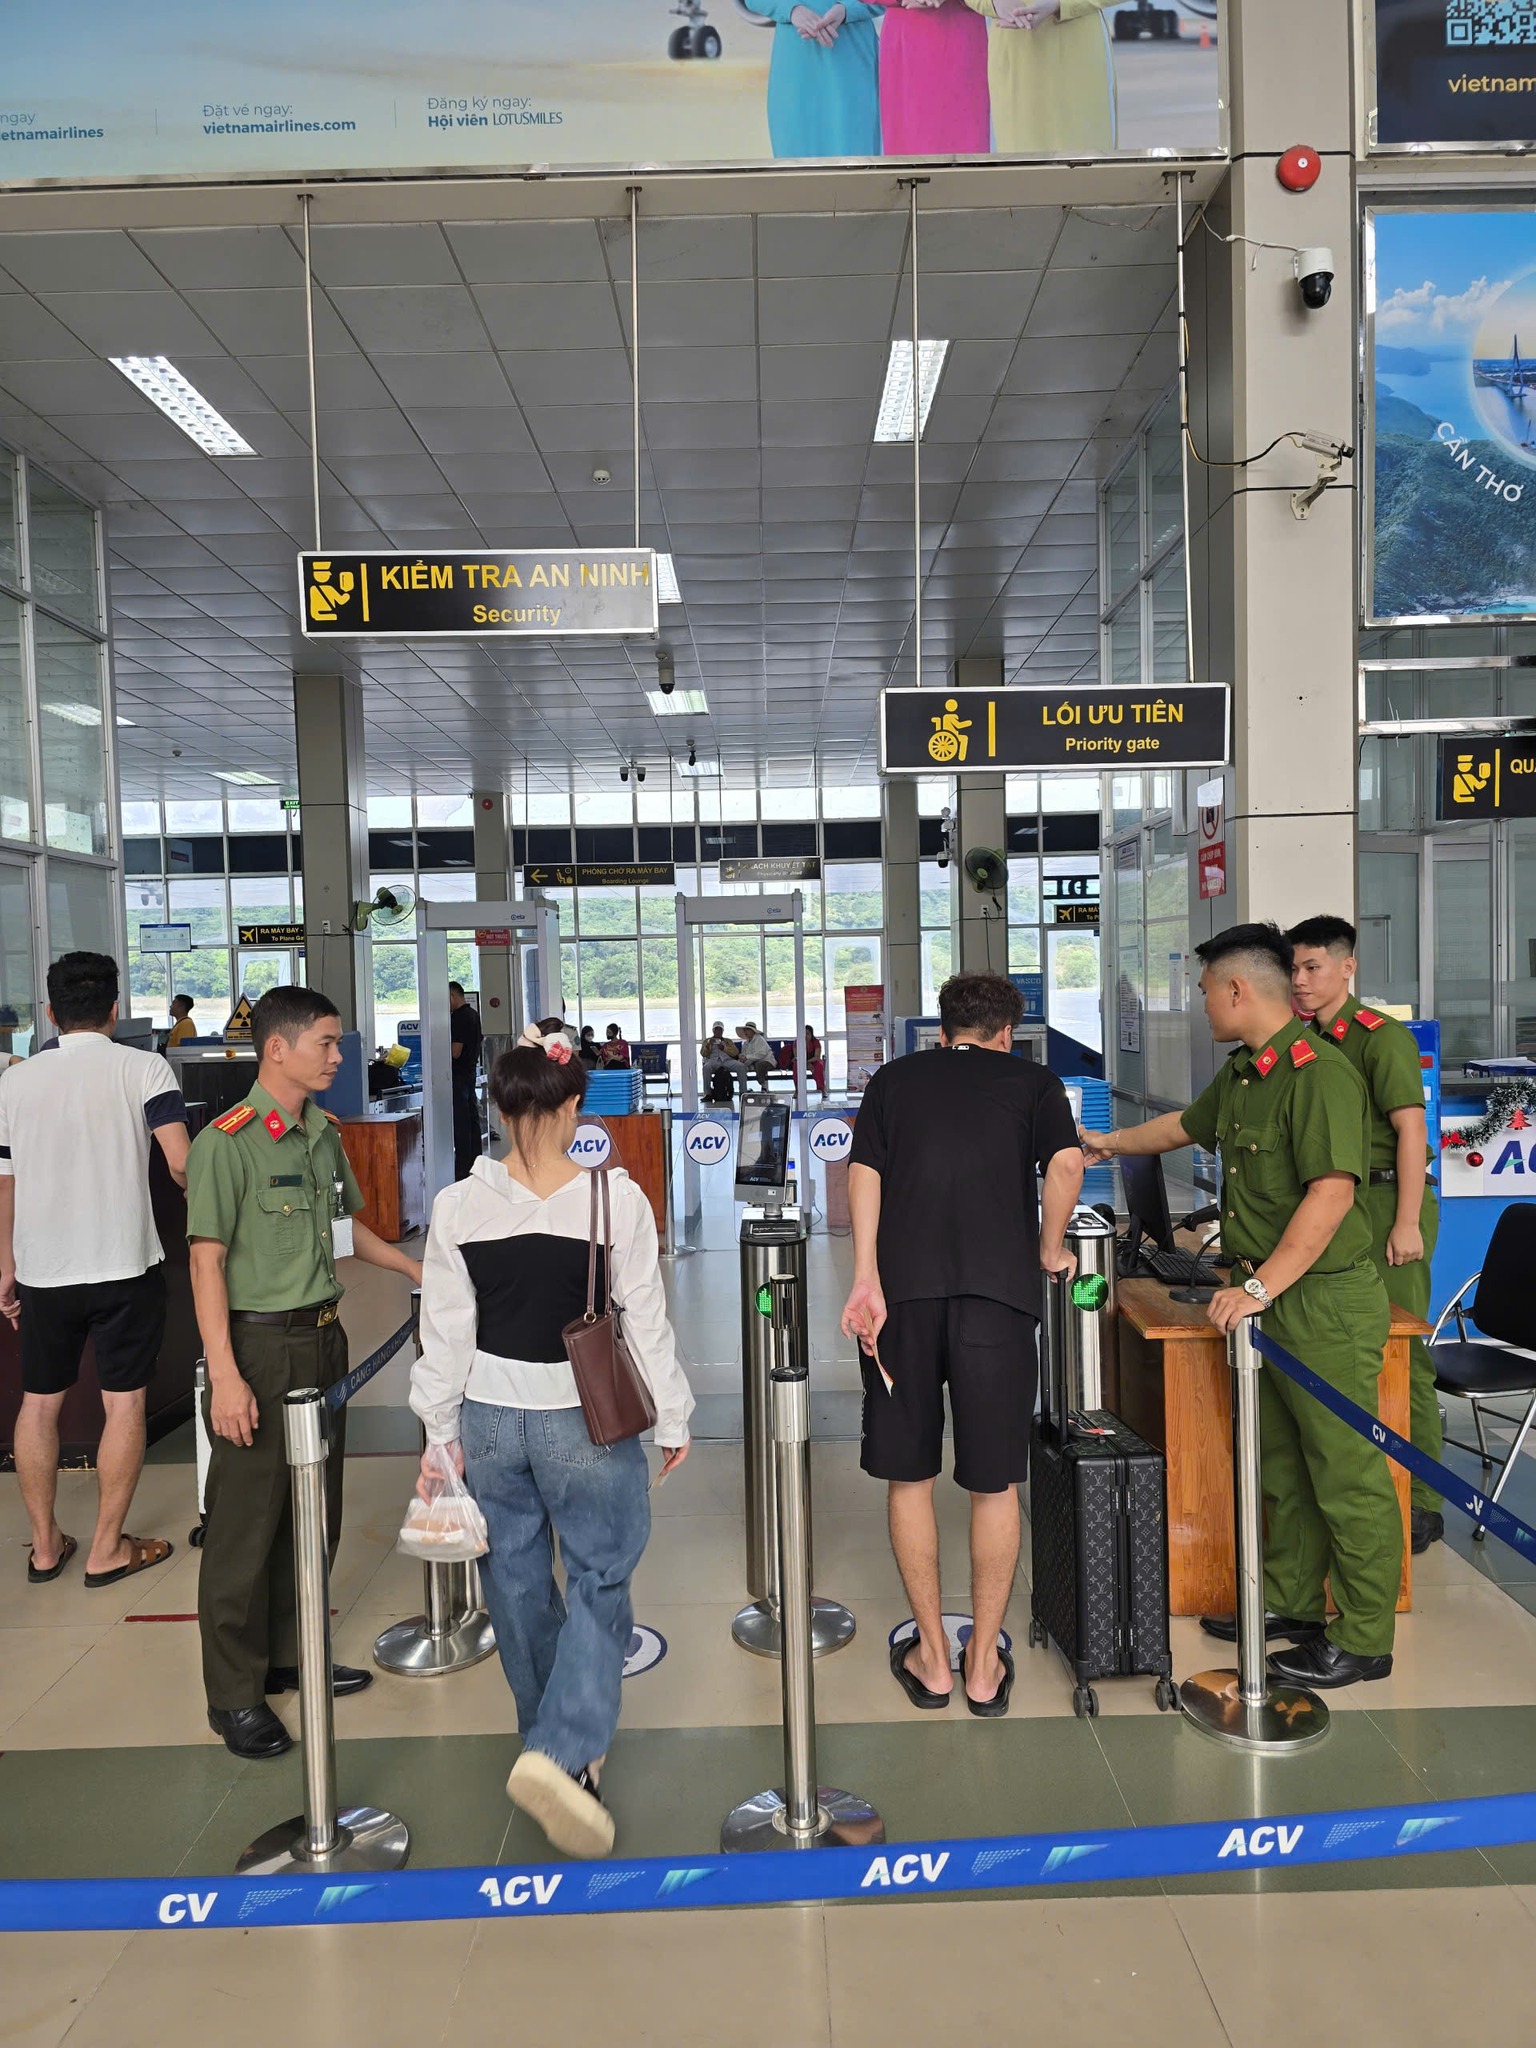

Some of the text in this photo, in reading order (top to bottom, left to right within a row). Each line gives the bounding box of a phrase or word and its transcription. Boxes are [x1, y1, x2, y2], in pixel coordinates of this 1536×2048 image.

[203, 103, 293, 119] Đặt vé ngay:
[427, 96, 532, 112] Đăng ký ngay:
[203, 120, 356, 134] vietnamairlines.com
[428, 112, 563, 130] Hội viên LOTUSMILES
[1437, 422, 1524, 502] CẦN THƠ
[381, 560, 650, 589] KIỂM TRA AN NINH
[473, 604, 562, 626] Security
[1042, 699, 1183, 726] LỐI ƯU TIÊN
[1065, 737, 1160, 754] Priority gate
[1510, 758, 1536, 774] QU
[400, 1023, 418, 1031] ACV
[570, 1139, 607, 1154] ACV
[690, 1136, 726, 1150] ACV
[813, 1132, 850, 1147] ACV
[1217, 1825, 1304, 1858] ACV
[860, 1851, 950, 1888] ACV
